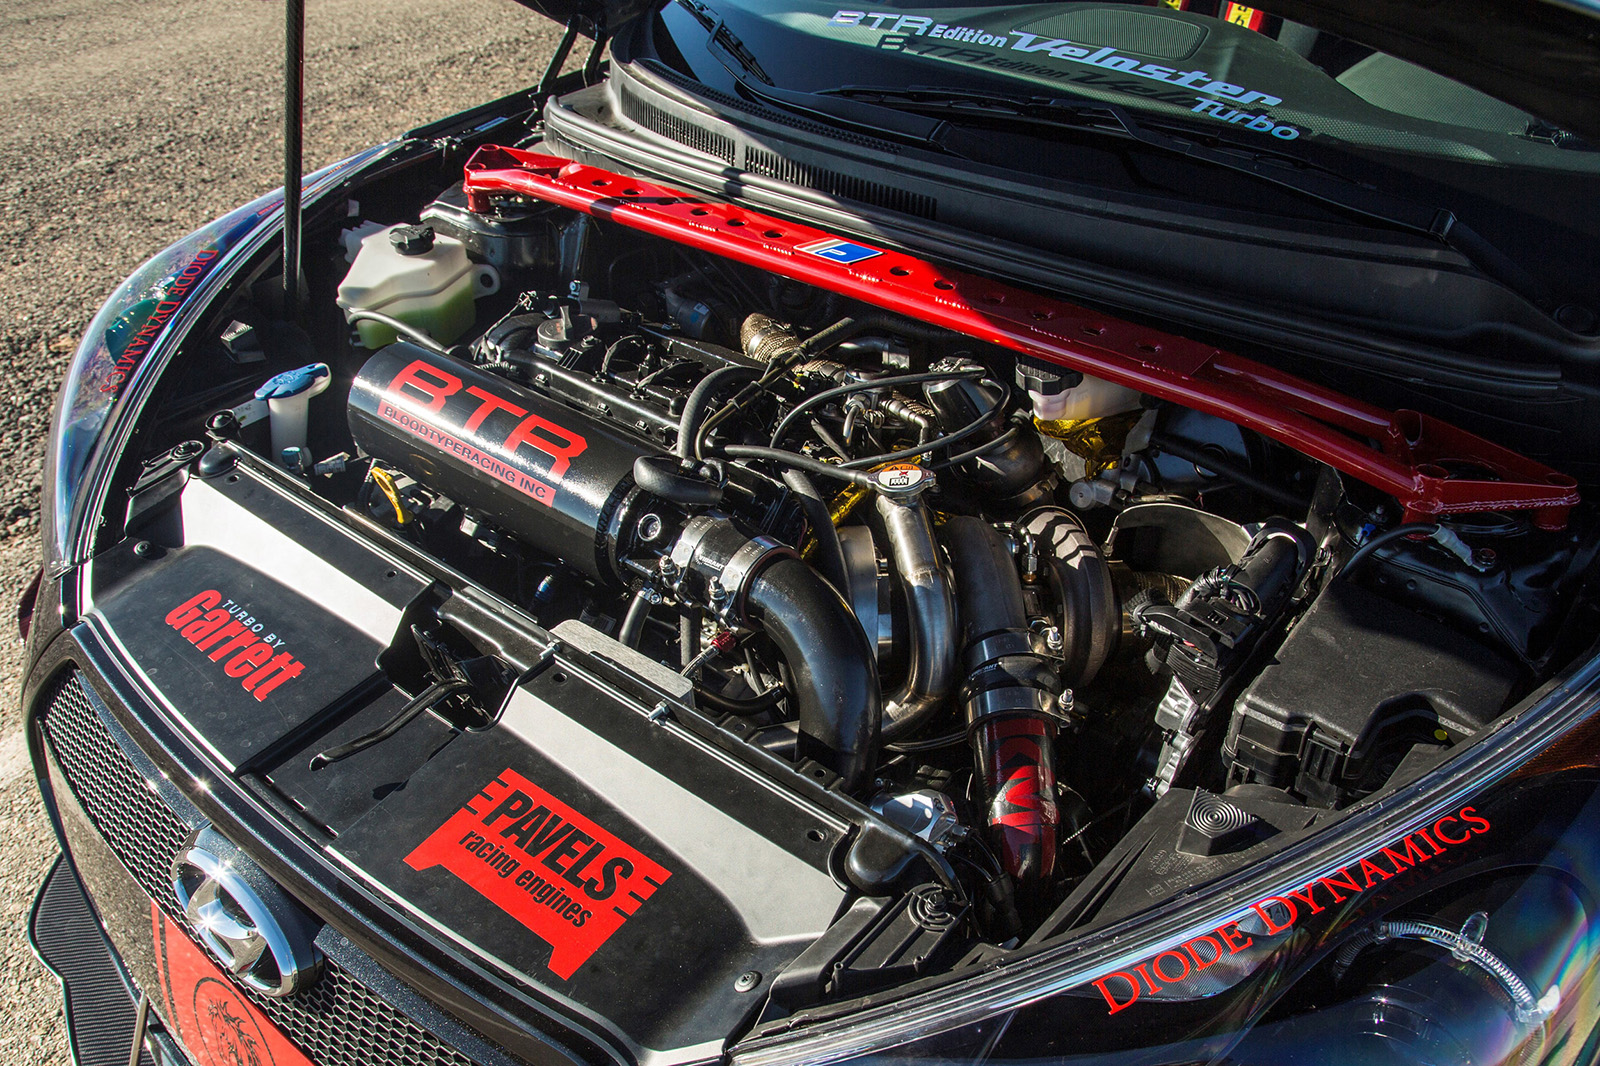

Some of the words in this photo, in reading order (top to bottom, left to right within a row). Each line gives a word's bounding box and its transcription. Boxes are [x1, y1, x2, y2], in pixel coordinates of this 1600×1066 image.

[827, 10, 933, 36] BTR
[928, 23, 1008, 48] Edition
[1009, 30, 1282, 106] Veloster
[1191, 97, 1299, 140] Turbo
[167, 249, 219, 296] DIODE
[100, 300, 181, 393] DYNAMICS
[384, 407, 516, 482] BLOODTYPERACING
[520, 478, 546, 499] INC
[387, 359, 588, 484] BTR
[165, 590, 306, 702] Garrett
[222, 599, 264, 632] TURBO
[263, 633, 285, 649] BY
[458, 830, 521, 879] racing
[515, 869, 593, 928] engines
[481, 789, 634, 901] PAVELS
[1092, 920, 1252, 1015] DIODE
[1249, 806, 1491, 936] DYNAMICS
